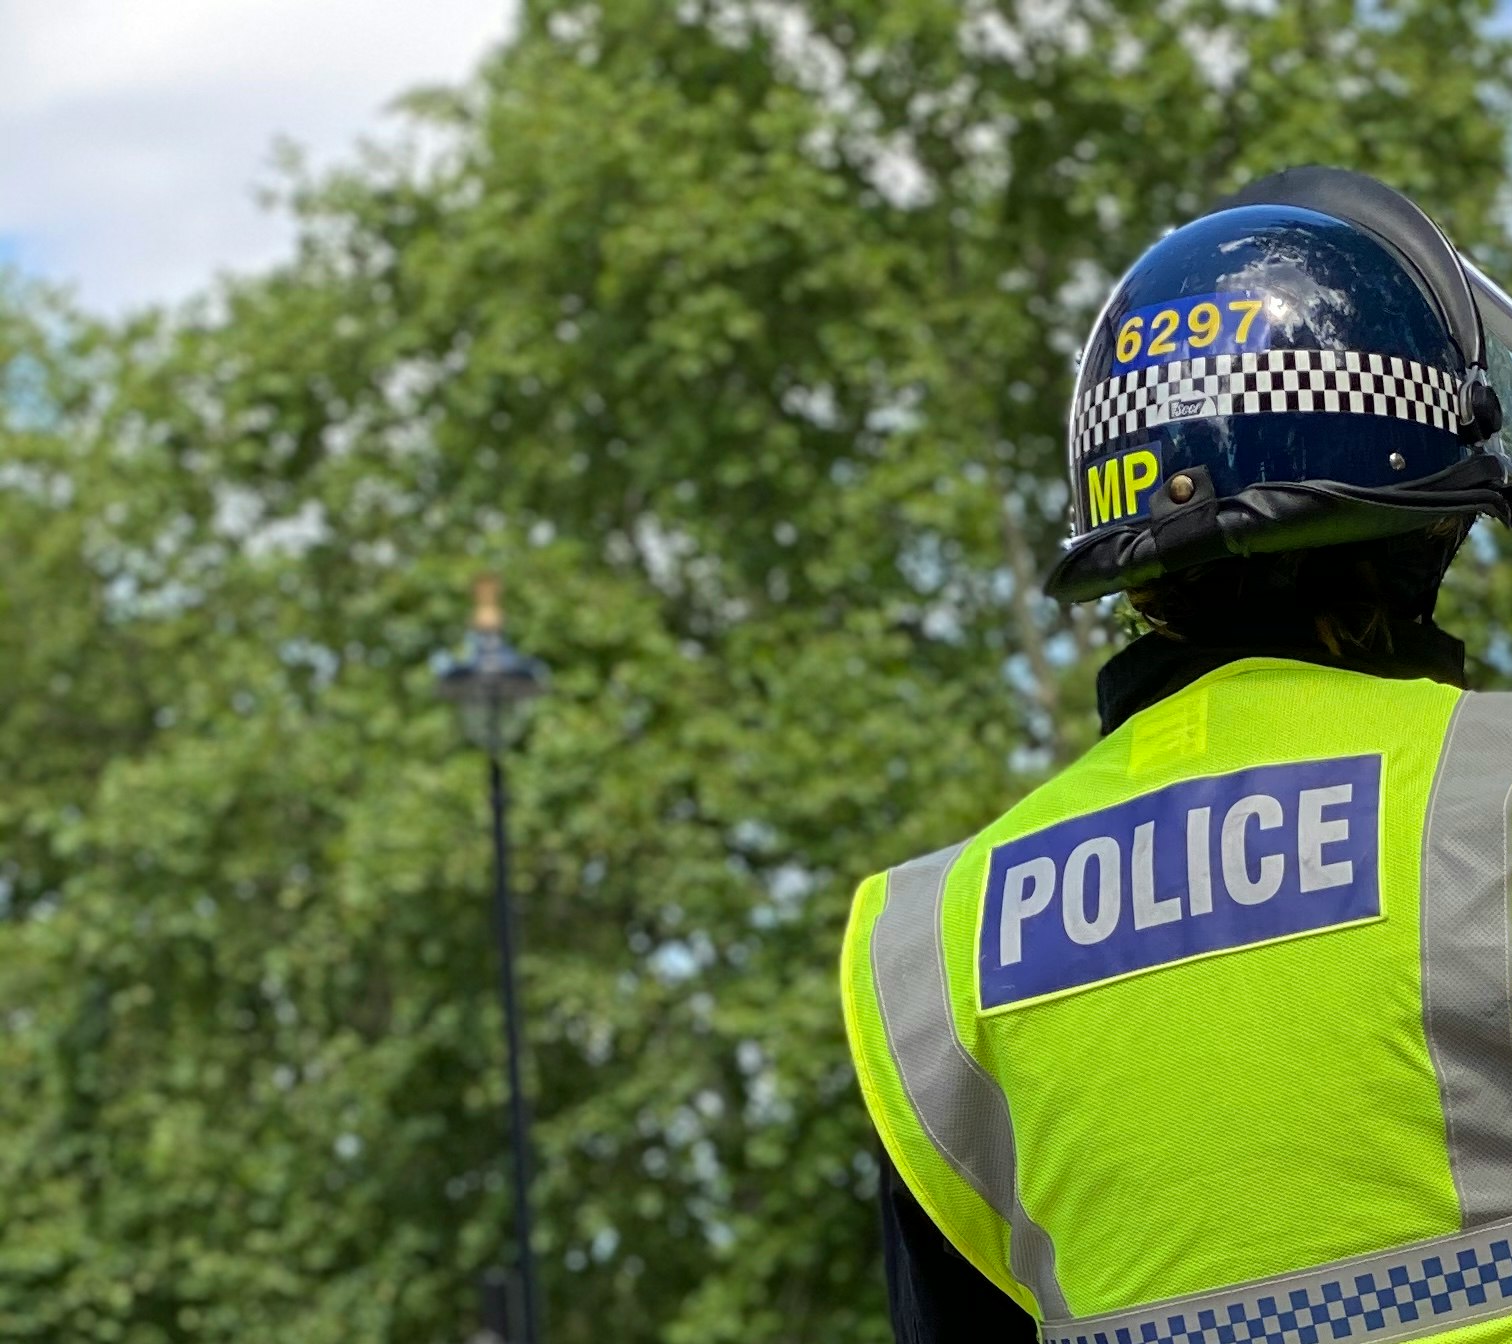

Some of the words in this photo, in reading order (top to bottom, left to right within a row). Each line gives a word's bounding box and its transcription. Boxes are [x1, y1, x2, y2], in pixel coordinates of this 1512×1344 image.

[1115, 300, 1263, 364] 6297
[1087, 450, 1158, 528] MP
[1000, 783, 1354, 967] POLICE
